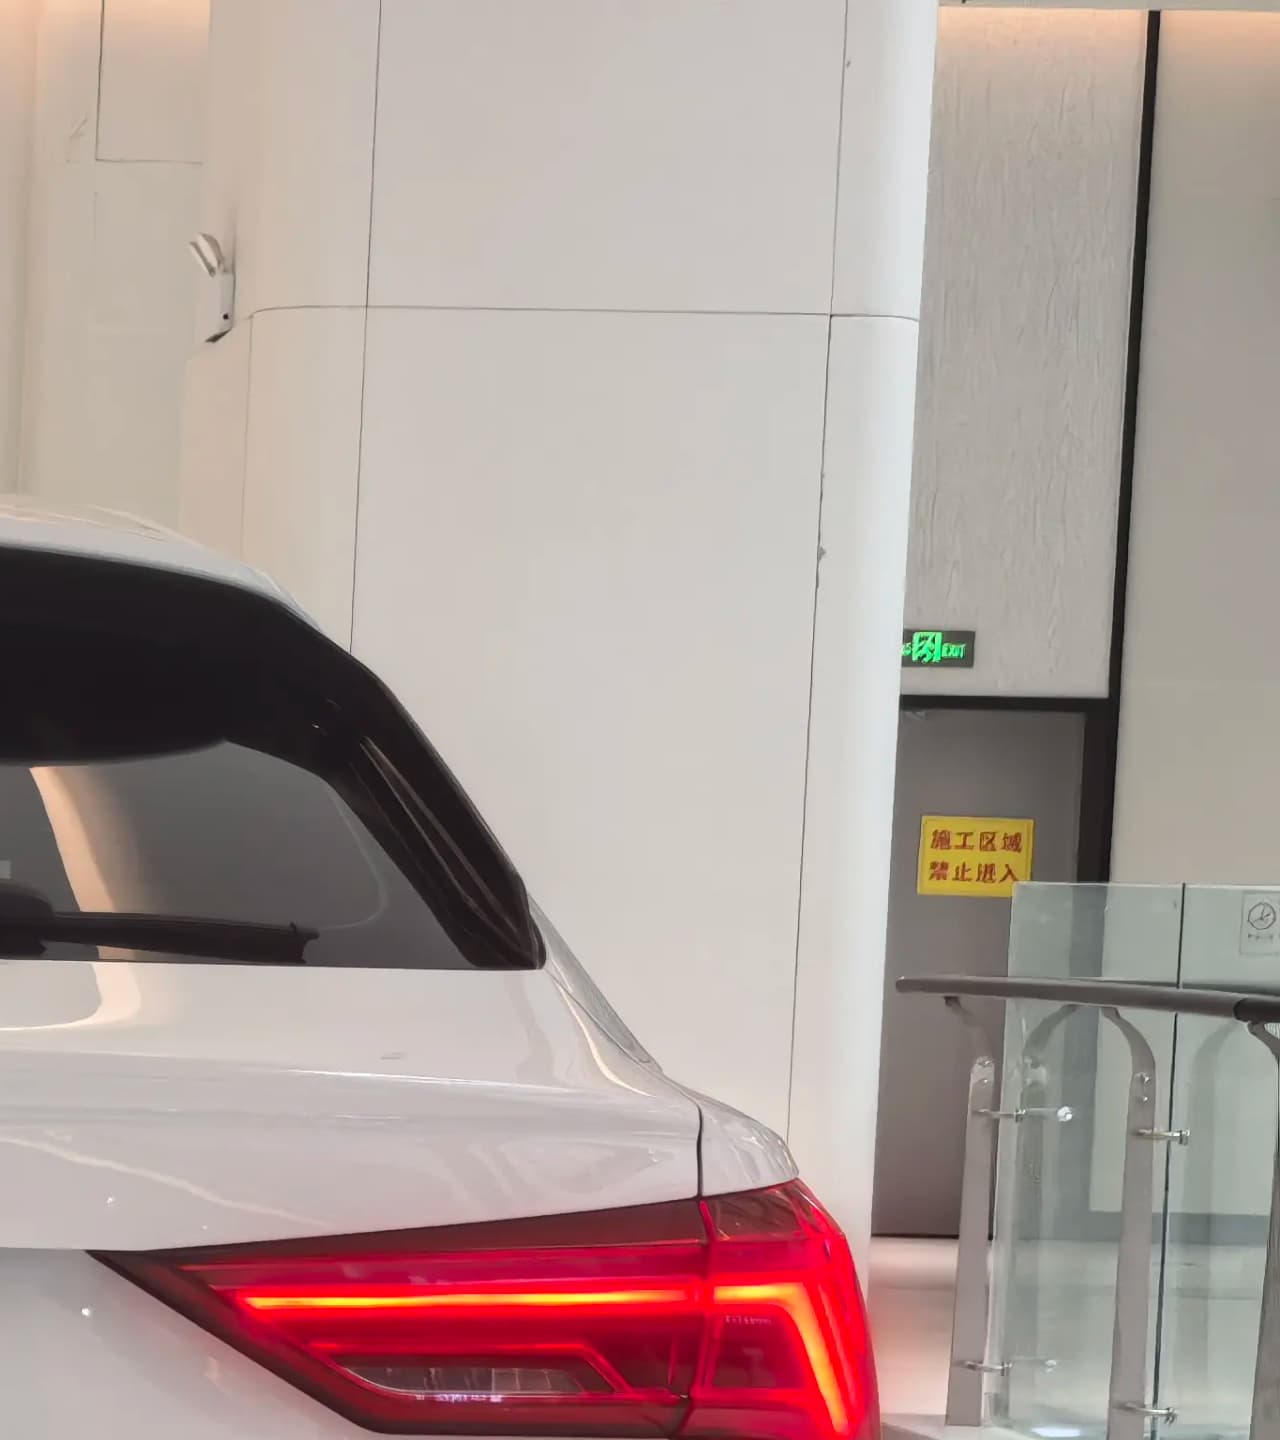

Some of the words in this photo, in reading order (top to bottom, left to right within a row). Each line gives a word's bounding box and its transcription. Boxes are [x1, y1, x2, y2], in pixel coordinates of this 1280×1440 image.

[930, 829, 1023, 853] 施工区域
[928, 861, 1018, 883] 禁止进入
